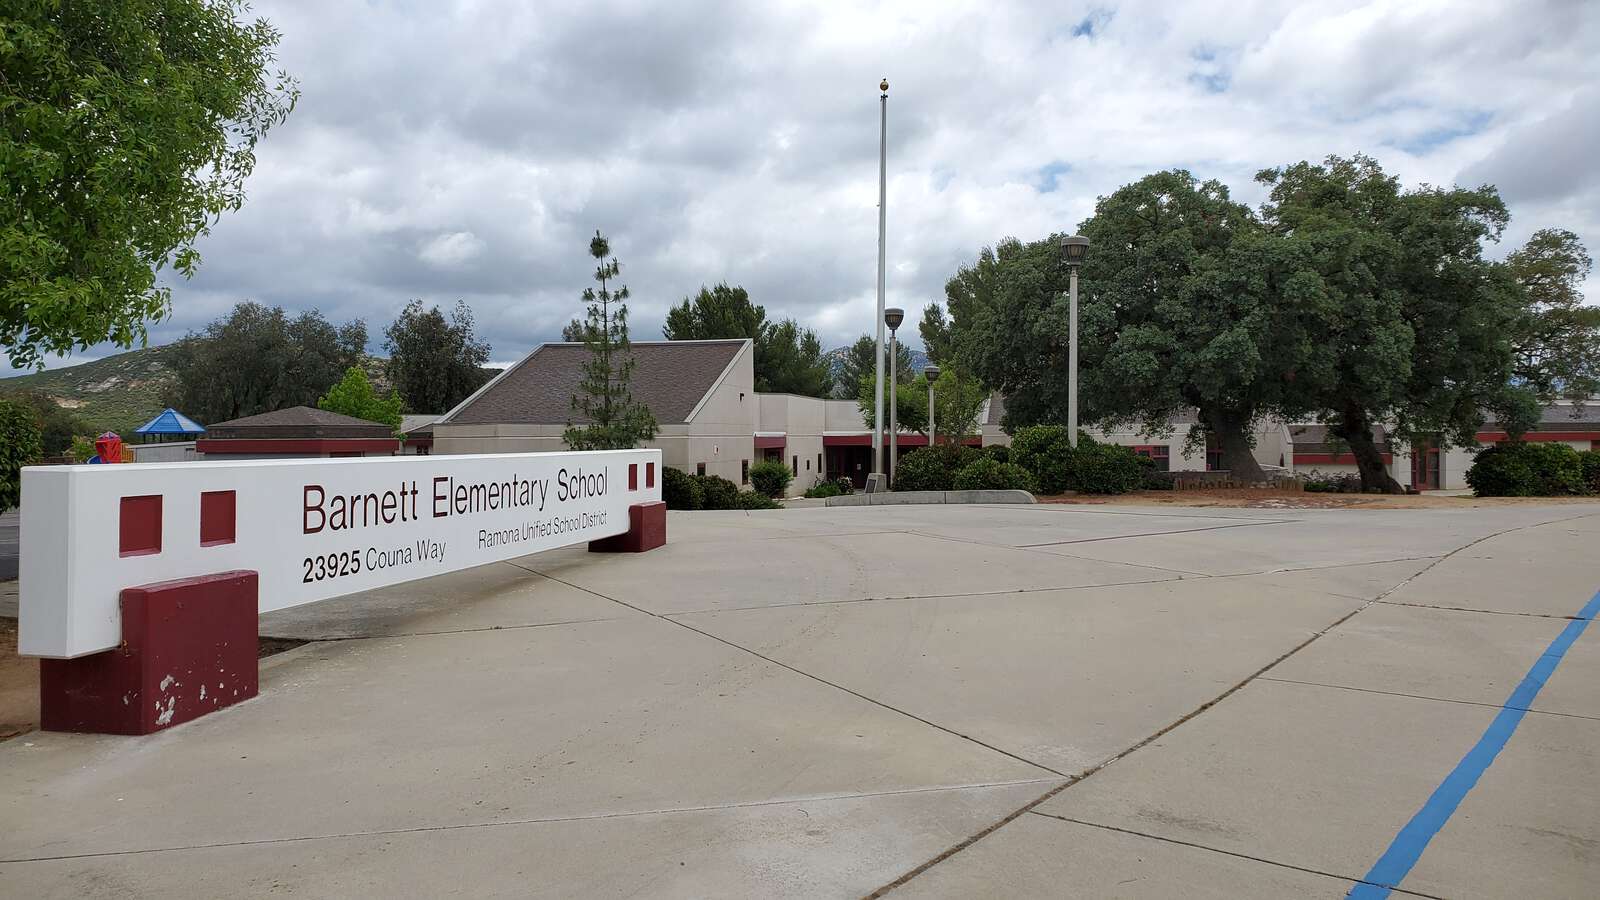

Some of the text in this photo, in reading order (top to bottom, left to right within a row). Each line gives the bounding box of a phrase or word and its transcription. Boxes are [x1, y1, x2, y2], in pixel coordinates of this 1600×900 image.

[303, 466, 608, 534] Barnett Elementary School
[478, 511, 607, 549] Ramona Unified School District
[302, 539, 447, 583] 23925 Couna Way
